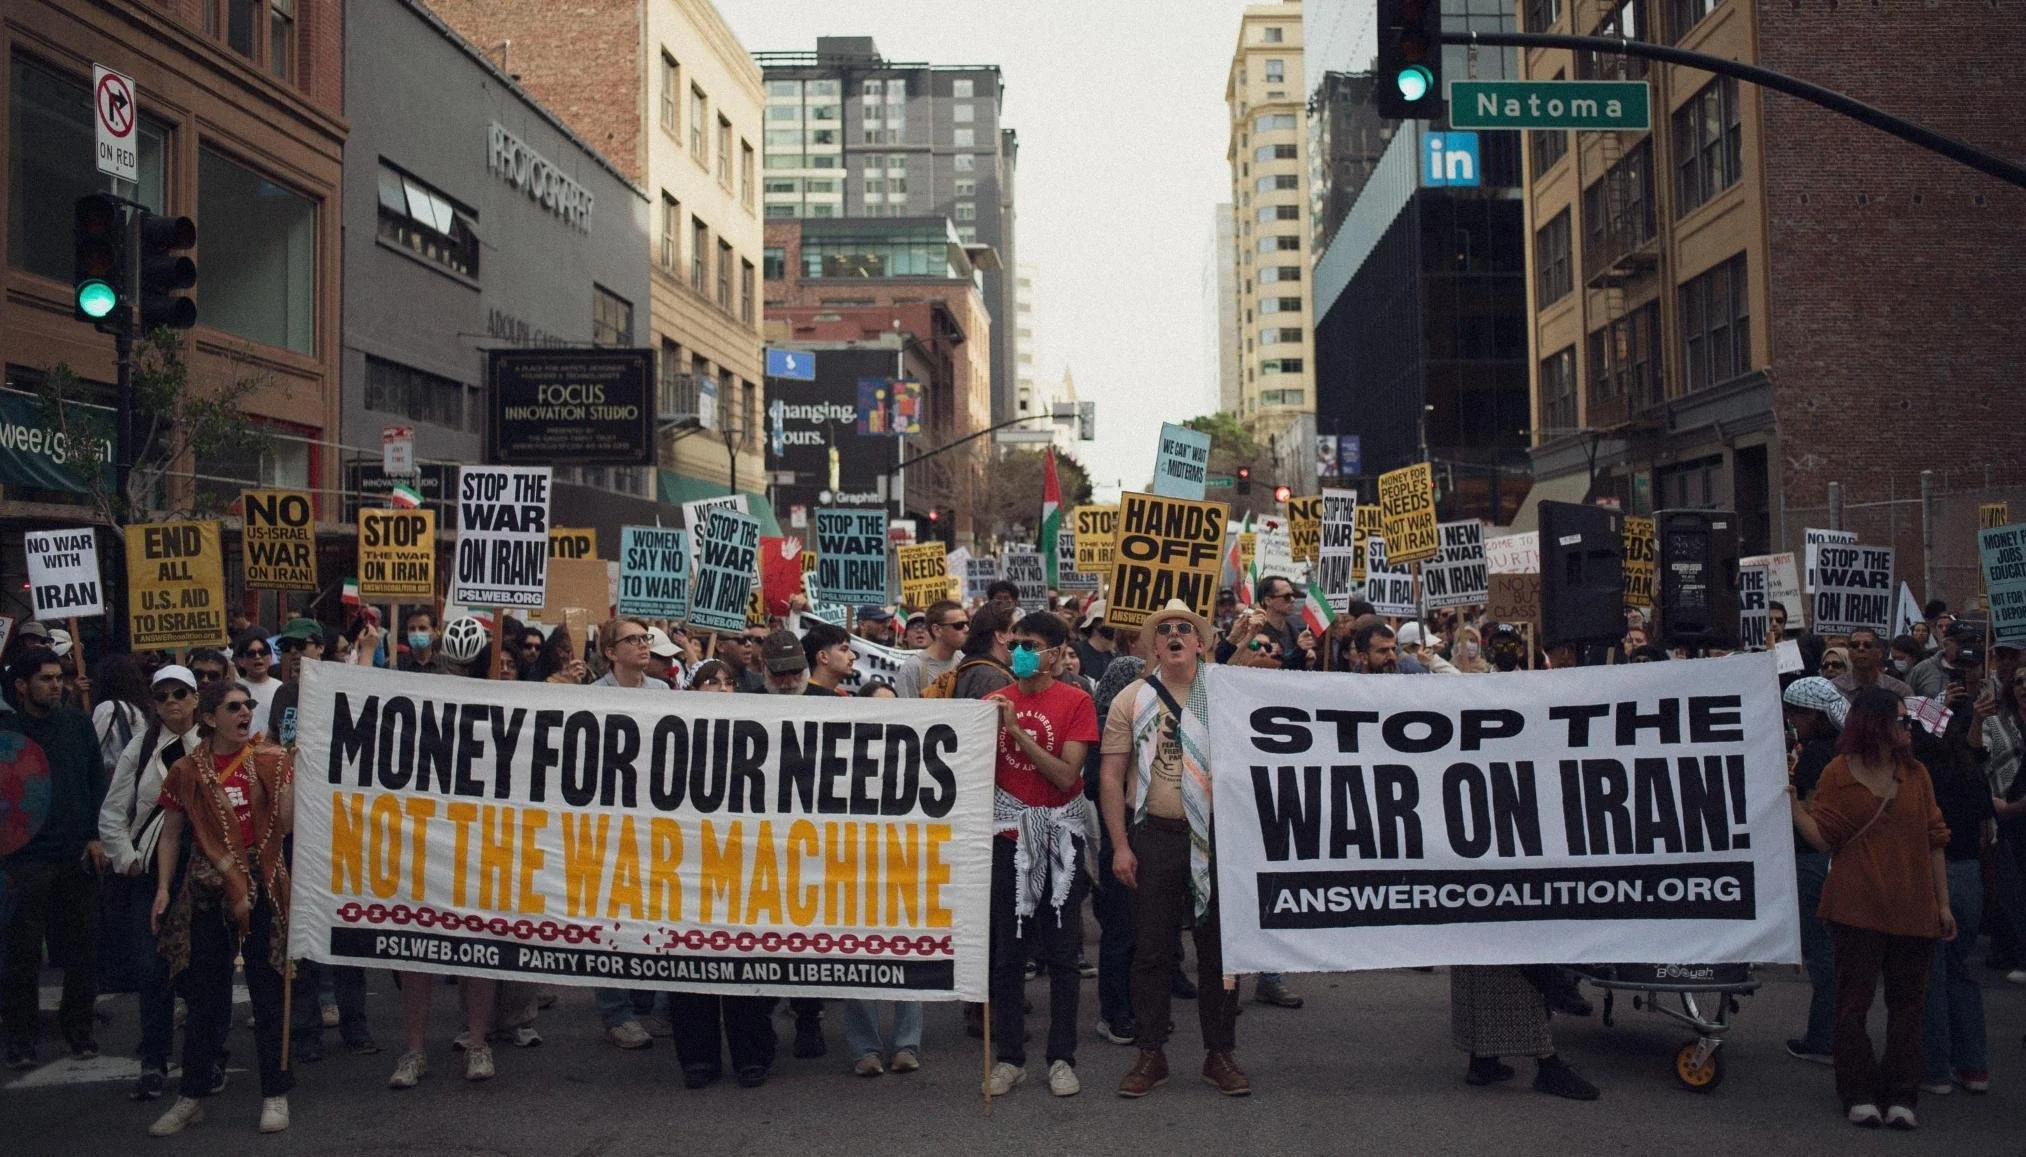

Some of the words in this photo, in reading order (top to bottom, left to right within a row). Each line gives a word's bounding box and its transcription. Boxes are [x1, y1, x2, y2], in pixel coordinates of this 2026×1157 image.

[1477, 92, 1622, 118] Natoma
[100, 142, 114, 159] ON
[117, 147, 135, 169] RED
[1430, 139, 1474, 179] in
[488, 121, 594, 231] PHOTOGRAPHY
[538, 384, 605, 404] FOCUS
[505, 406, 586, 420] INNOVATION
[589, 405, 638, 420] STUDIO
[1163, 438, 1175, 455] WE
[1167, 458, 1204, 484] MIDTERMS
[1381, 471, 1410, 487] MONEY
[1410, 467, 1426, 481] FOR
[462, 473, 508, 501] STOP
[513, 474, 547, 503] THE
[1382, 479, 1428, 499] PEOPLE'S
[245, 495, 310, 527] NO
[1324, 497, 1339, 521] STOP
[1339, 497, 1354, 522] THE
[1383, 491, 1430, 517] NEEDS
[461, 503, 546, 533] WAR
[818, 514, 853, 535] STOP
[857, 515, 884, 535] THE
[1125, 498, 1222, 542] HANDS
[1385, 517, 1406, 536] NOT
[1408, 514, 1432, 530] WAR
[144, 525, 201, 559] END
[247, 527, 310, 540] US-ISRAEL
[364, 515, 427, 547] STOP
[633, 530, 680, 549] WOMEN
[707, 513, 739, 542] STOP
[740, 520, 759, 548] THE
[1293, 530, 1320, 546] WA
[1323, 523, 1352, 547] WAR
[1404, 528, 1435, 550] IRAN
[1445, 523, 1480, 546] NEW
[1984, 531, 2017, 551] MONEY
[27, 538, 50, 553] NO
[53, 534, 93, 551] WAR
[248, 542, 311, 568] WAR
[549, 535, 591, 559] TOP
[819, 536, 884, 555] WAR
[1121, 535, 1219, 567] OFF
[1449, 545, 1484, 562] WAR
[43, 553, 81, 568] WITH
[364, 552, 392, 560] THE
[459, 538, 487, 584] ON
[491, 540, 546, 587] IRAN!
[627, 548, 657, 571] SAY
[660, 551, 683, 573] NO
[705, 540, 755, 573] WAR
[1008, 556, 1039, 567] WOMEN
[1080, 549, 1094, 562] ON
[1820, 548, 1859, 568] STOP
[1862, 550, 1890, 570] THE
[1997, 547, 2024, 564] JOBS
[158, 561, 192, 581] ALL
[249, 567, 269, 580] ON
[274, 567, 313, 581] IRAN!
[364, 562, 385, 581] ON
[391, 562, 429, 581] IRAN
[820, 559, 840, 589] ON
[844, 560, 884, 591] IRAN!
[902, 557, 946, 580] NEEDS
[1007, 567, 1025, 582] SAY
[1027, 568, 1042, 581] NO
[1320, 556, 1329, 595] ON
[1425, 568, 1448, 596] ON
[1449, 563, 1488, 593] IRAN!
[1820, 568, 1889, 589] WAR
[1990, 562, 2026, 580] EDUCAT
[35, 581, 98, 610] IRAN
[458, 589, 542, 603] PSLWEB.ORG
[623, 575, 642, 597] TO
[645, 578, 686, 600] WAR!
[695, 568, 717, 609] ON
[716, 574, 750, 616] IRAN!
[822, 592, 884, 601] PSLWEB.ORG
[1020, 585, 1046, 599] WAR!
[1113, 563, 1214, 618] IRAN!
[1368, 578, 1386, 603] ON
[1498, 578, 1524, 592] NO
[142, 590, 176, 610] U.S.
[181, 588, 209, 608] AID
[1818, 592, 1840, 621] ON
[1845, 593, 1889, 624] IRAN!
[2007, 591, 2023, 604] FOR
[134, 614, 155, 633] TO
[159, 611, 220, 631] ISRAEL!
[690, 612, 745, 630] PSLWEB.ORG
[1495, 604, 1537, 617] CLASS
[1034, 711, 1055, 752] LIBERATIO
[1249, 706, 1525, 754] STOP
[1548, 694, 1744, 748] THE
[328, 691, 527, 799] MONEY
[529, 709, 641, 808] FOR
[649, 714, 769, 813] OUR
[777, 721, 958, 818] NEEDS
[1250, 763, 1424, 862] WAR
[1441, 760, 1543, 859] ON
[1558, 754, 1752, 857] IRAN!
[330, 790, 436, 901] NOT
[447, 802, 549, 915] THE
[561, 811, 684, 922] WAR
[700, 819, 954, 928] MACHINE
[1273, 875, 1741, 914] ANSWERCOALITION.ORG
[376, 936, 499, 965] PSLWEB.ORG
[518, 948, 578, 972] PARTY
[585, 954, 624, 975] FOR
[630, 957, 735, 981] SOCIALISM
[742, 963, 781, 981] AND
[789, 964, 905, 984] LIBERATION
